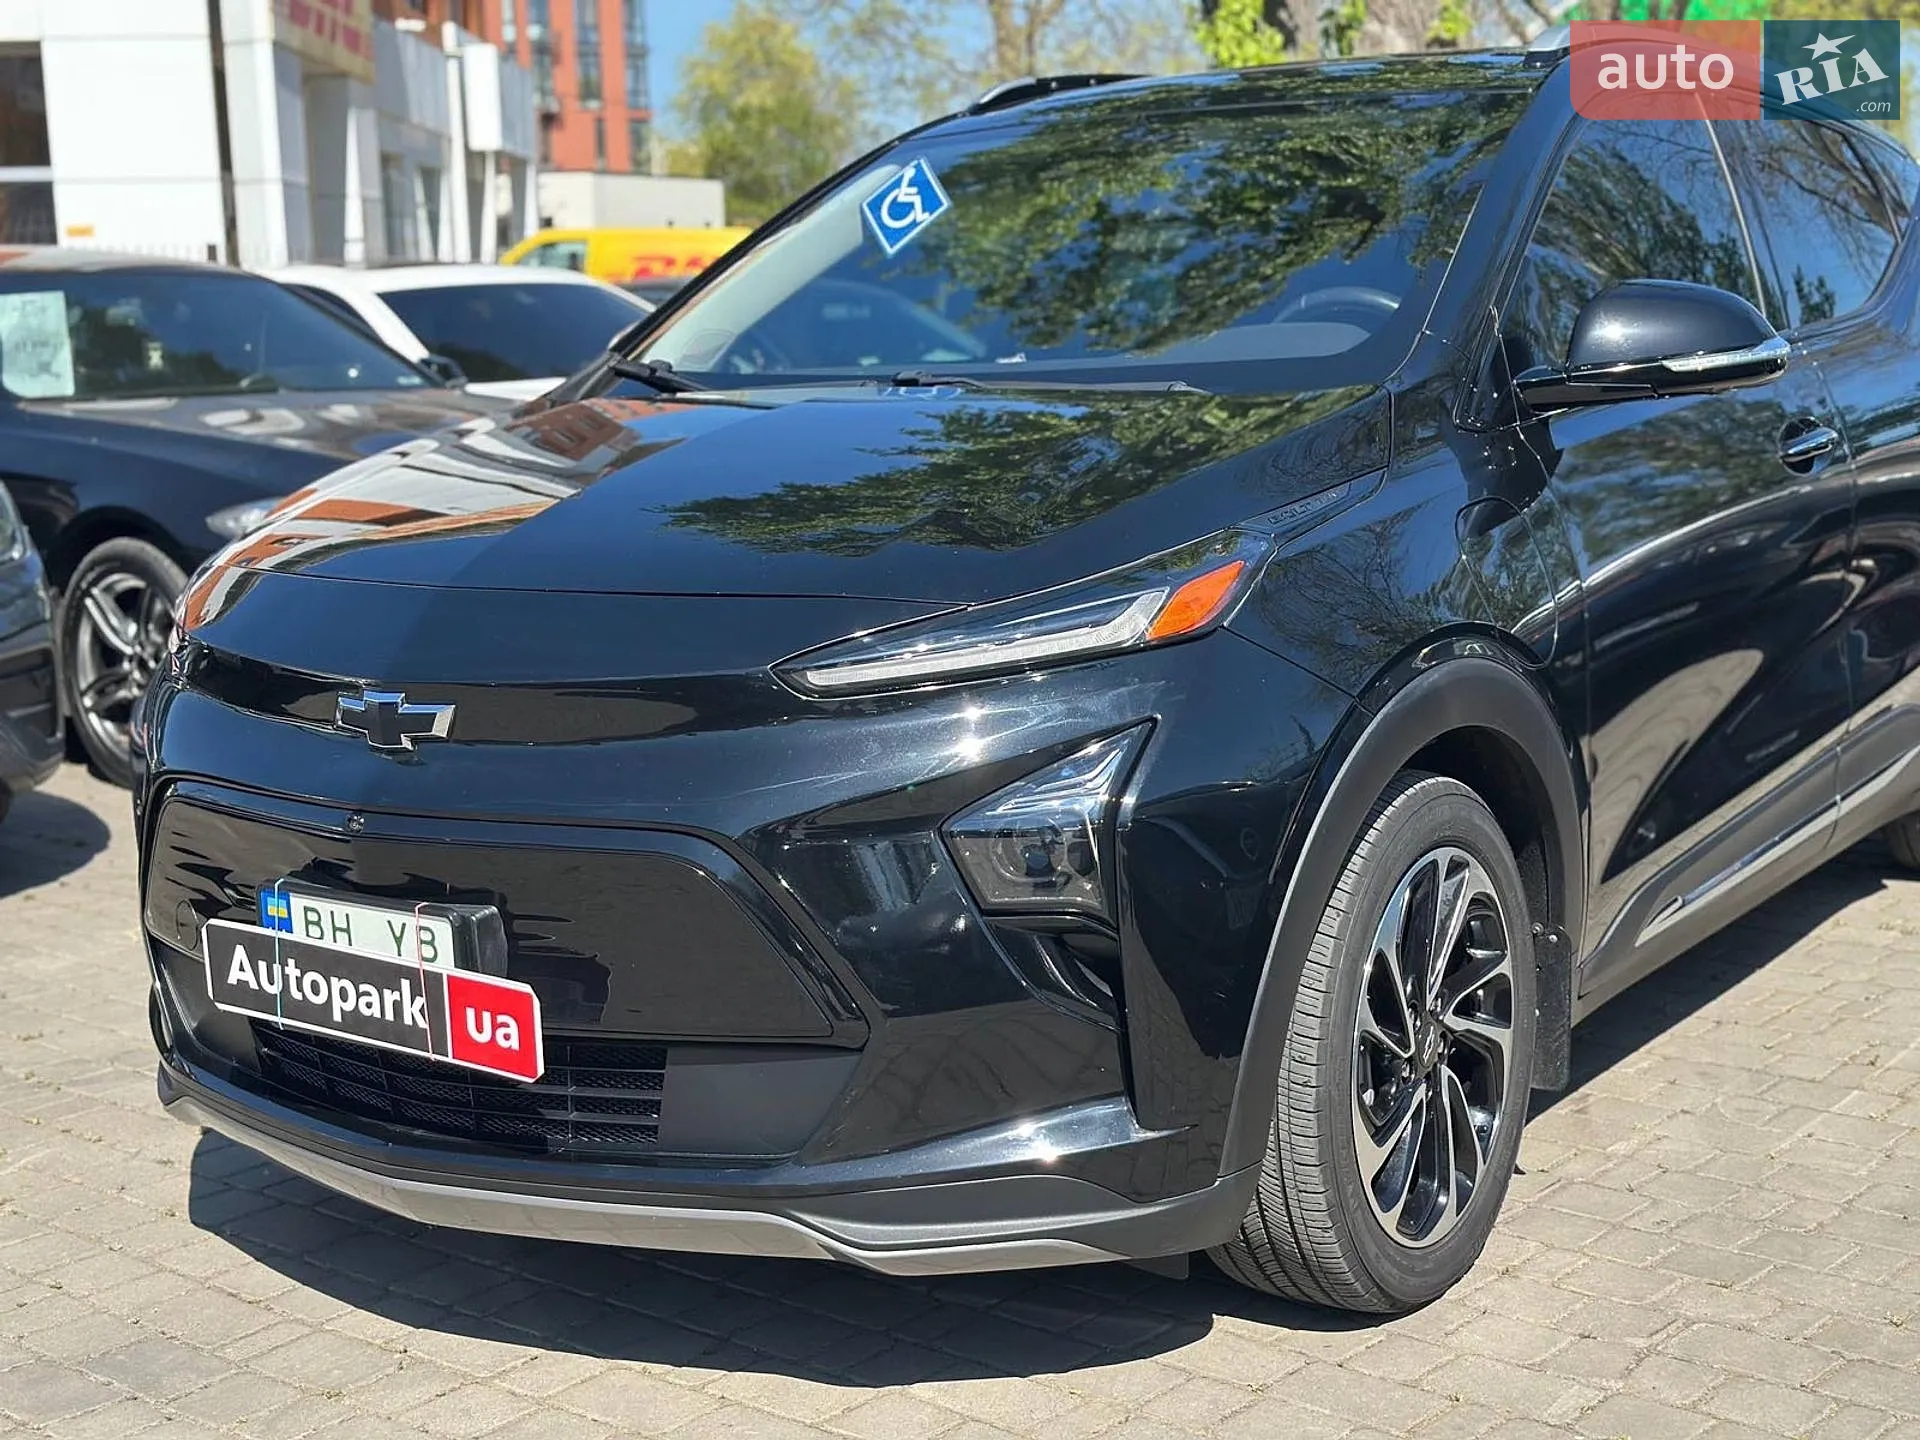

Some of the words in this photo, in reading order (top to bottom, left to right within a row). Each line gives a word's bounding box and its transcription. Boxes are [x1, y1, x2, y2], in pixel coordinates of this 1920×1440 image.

[303, 905, 353, 947] BH
[387, 919, 438, 963] YB
[227, 944, 429, 1029] Autopark
[465, 1006, 520, 1051] ua
